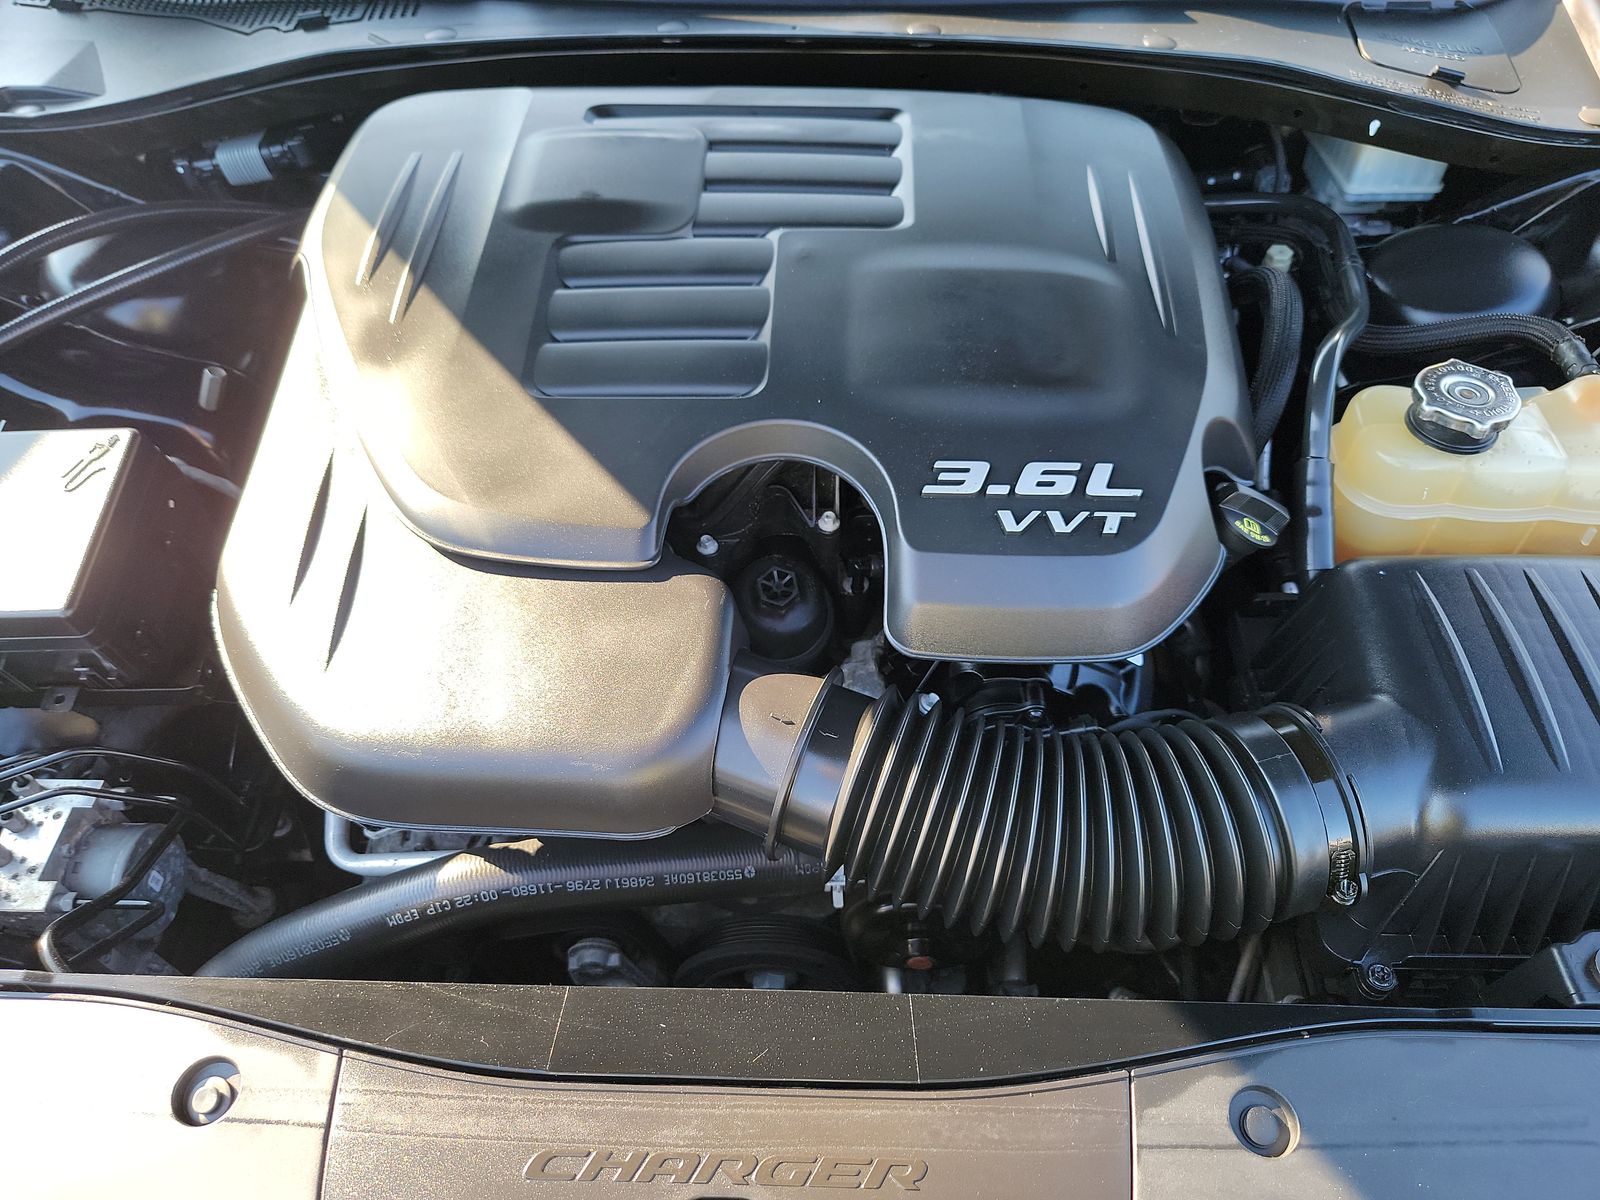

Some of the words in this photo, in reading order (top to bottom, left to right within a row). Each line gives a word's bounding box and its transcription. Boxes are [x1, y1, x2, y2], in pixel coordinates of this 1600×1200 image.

[1402, 44, 1466, 62] ACCESS
[1437, 39, 1482, 55] FLUID
[1498, 378, 1516, 404] KEEP
[921, 460, 1143, 497] 3.6L
[997, 510, 1137, 535] VVT
[663, 868, 743, 886] 55038160AE
[426, 899, 451, 916] CIP
[386, 908, 420, 928] EPDM
[523, 1149, 930, 1191] CHARGER
